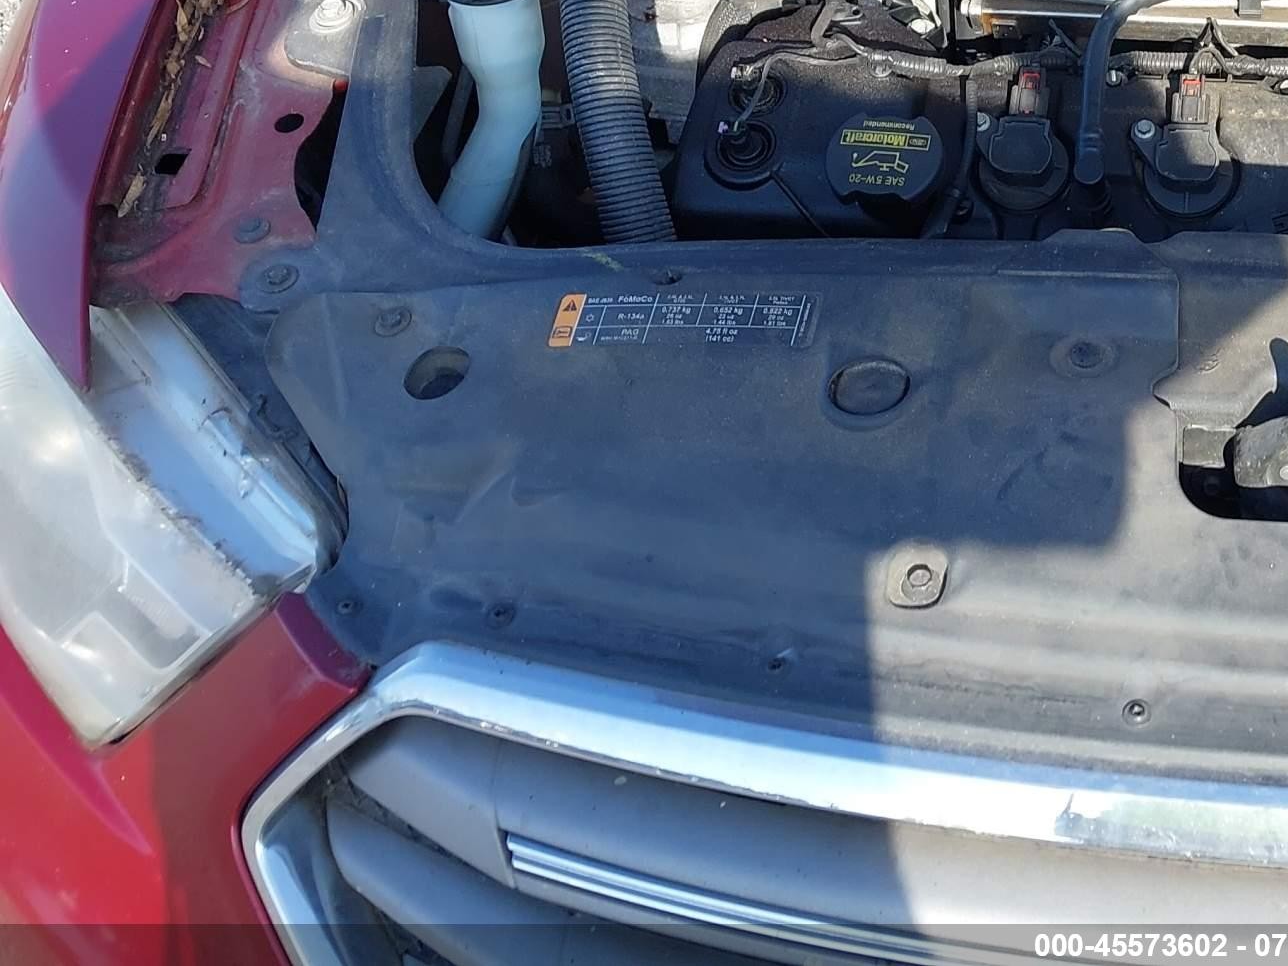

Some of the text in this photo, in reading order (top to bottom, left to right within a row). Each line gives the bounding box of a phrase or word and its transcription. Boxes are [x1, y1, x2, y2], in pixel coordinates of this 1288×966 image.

[863, 120, 915, 130] Recommended
[846, 131, 905, 146] Motorcraft
[849, 173, 905, 186] SAE 5W-20
[618, 295, 653, 303] FoMoCo
[733, 307, 744, 316] kg
